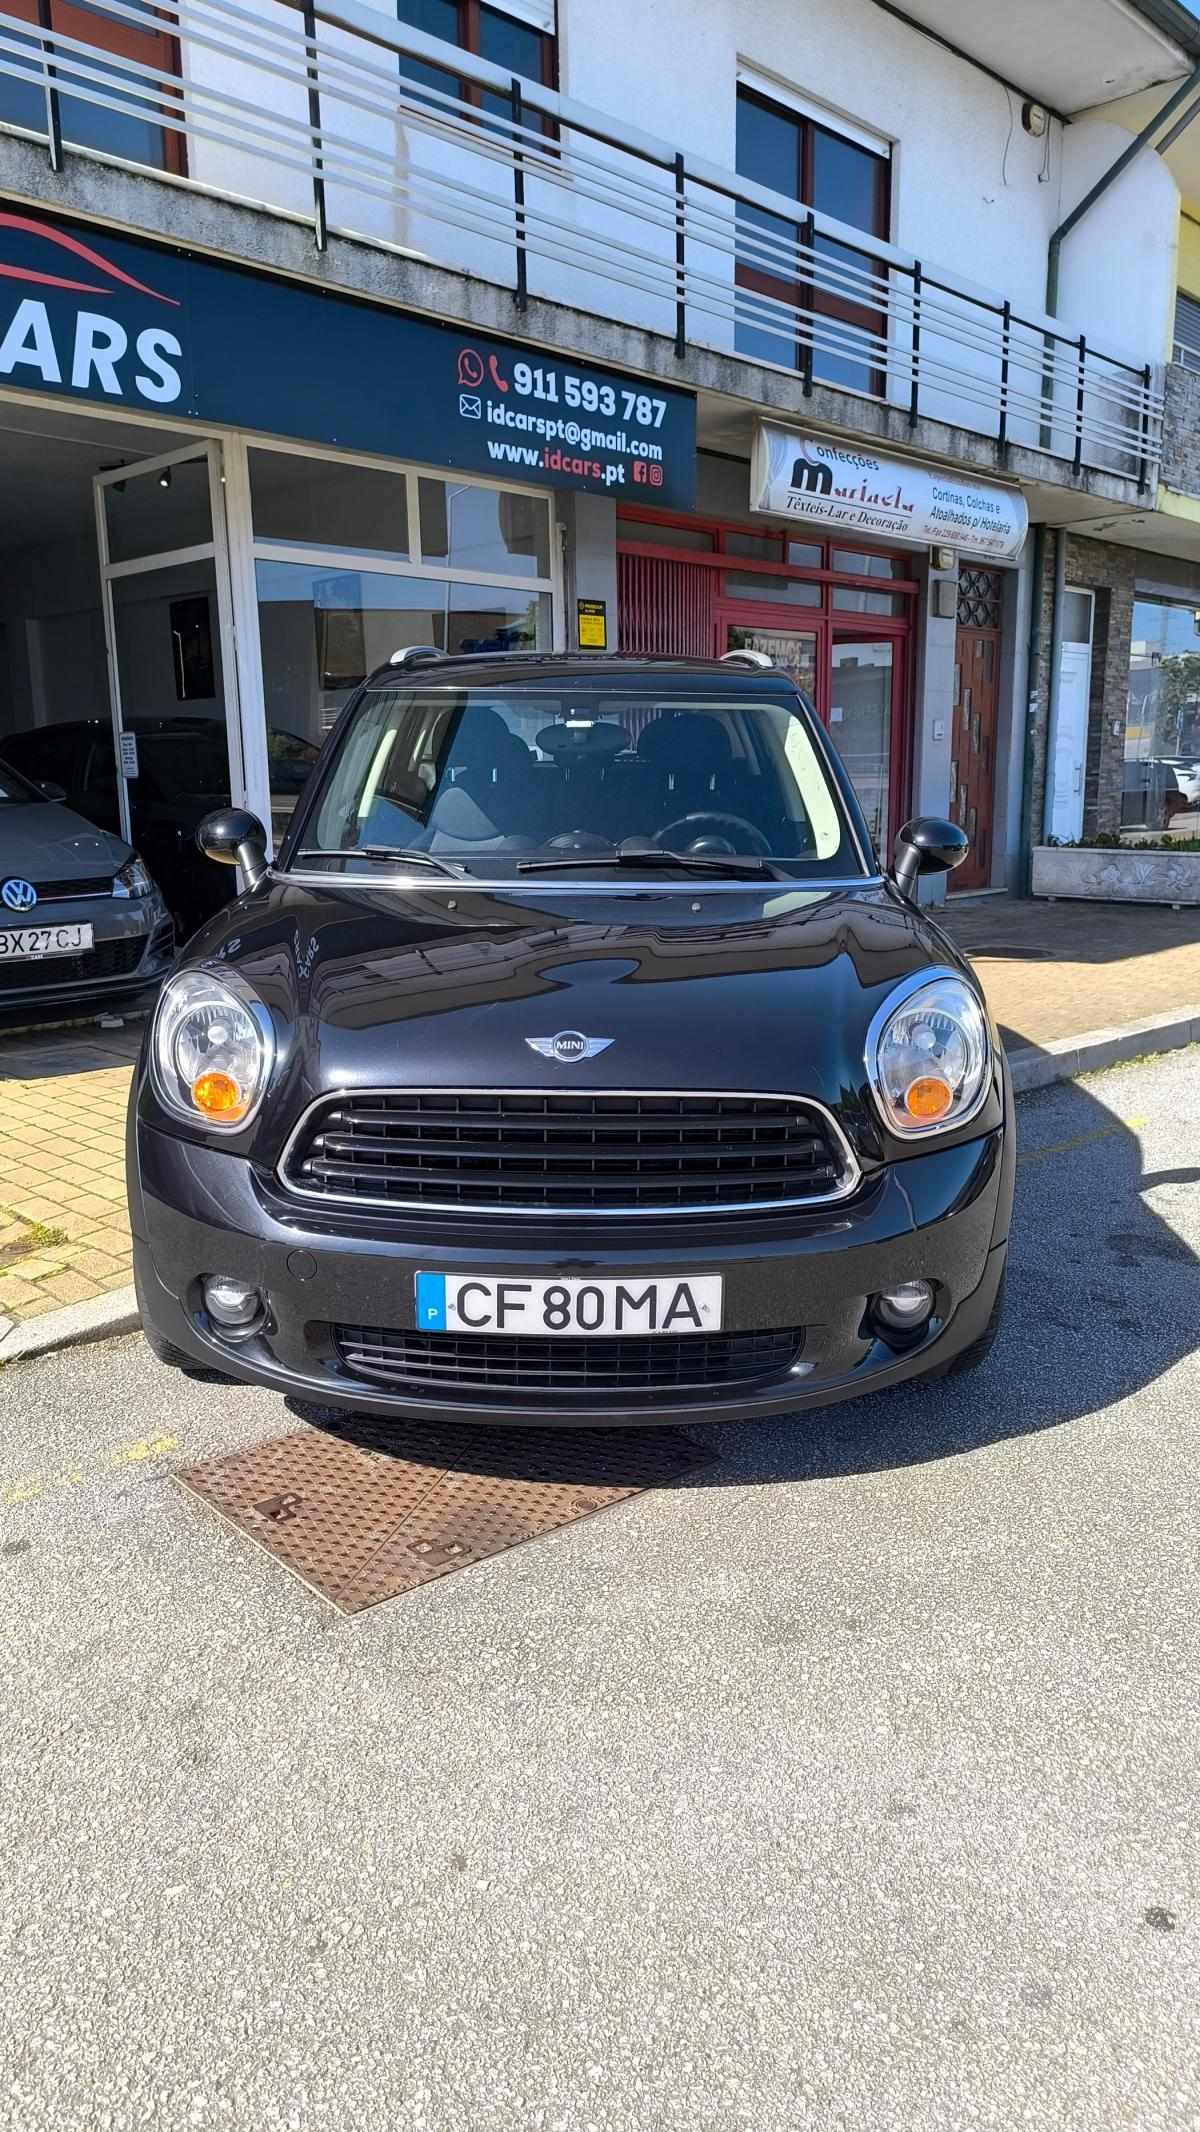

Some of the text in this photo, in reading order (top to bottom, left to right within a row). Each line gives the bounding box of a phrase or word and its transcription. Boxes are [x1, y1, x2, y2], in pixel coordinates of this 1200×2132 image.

[513, 362, 667, 428] 911 593 787
[486, 400, 663, 461] idcarspt@gmail.com
[487, 440, 625, 486] www.idcars.pt
[849, 510, 857, 521] e
[857, 511, 909, 532] Decoração
[966, 495, 994, 513] Colchas
[28, 931, 51, 952] 27
[56, 927, 82, 949] CJ
[556, 1040, 584, 1050] MINI
[428, 1282, 704, 1331] P CF 80 MA
